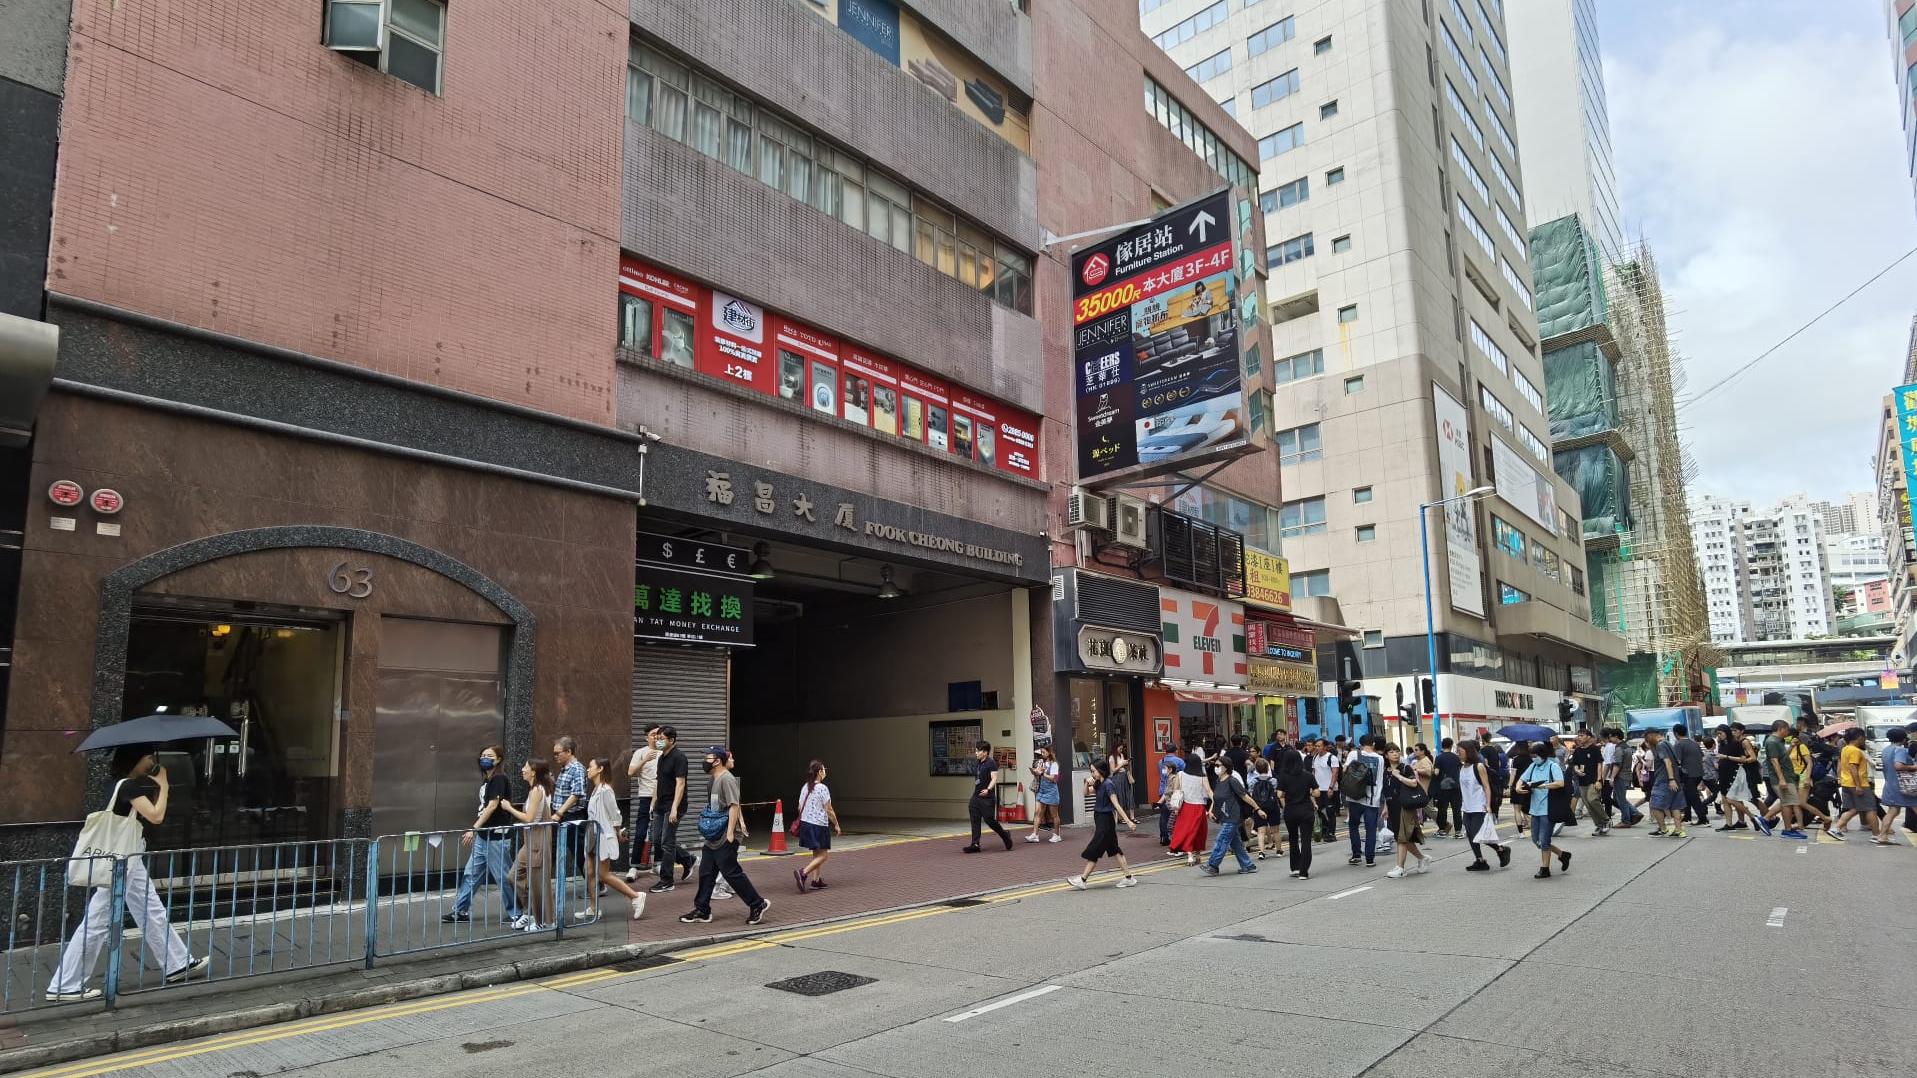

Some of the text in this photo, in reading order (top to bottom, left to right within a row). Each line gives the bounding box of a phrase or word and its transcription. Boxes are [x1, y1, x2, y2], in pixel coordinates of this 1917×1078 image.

[1115, 243, 1184, 276] Furniture Station
[1116, 224, 1174, 266] 傢居站
[864, 520, 1023, 567] FOOK CHEONG BUILDING
[328, 562, 374, 598] 63
[650, 618, 663, 626] TAT
[669, 620, 697, 629] MONEY
[701, 623, 741, 633] EXCHANGE
